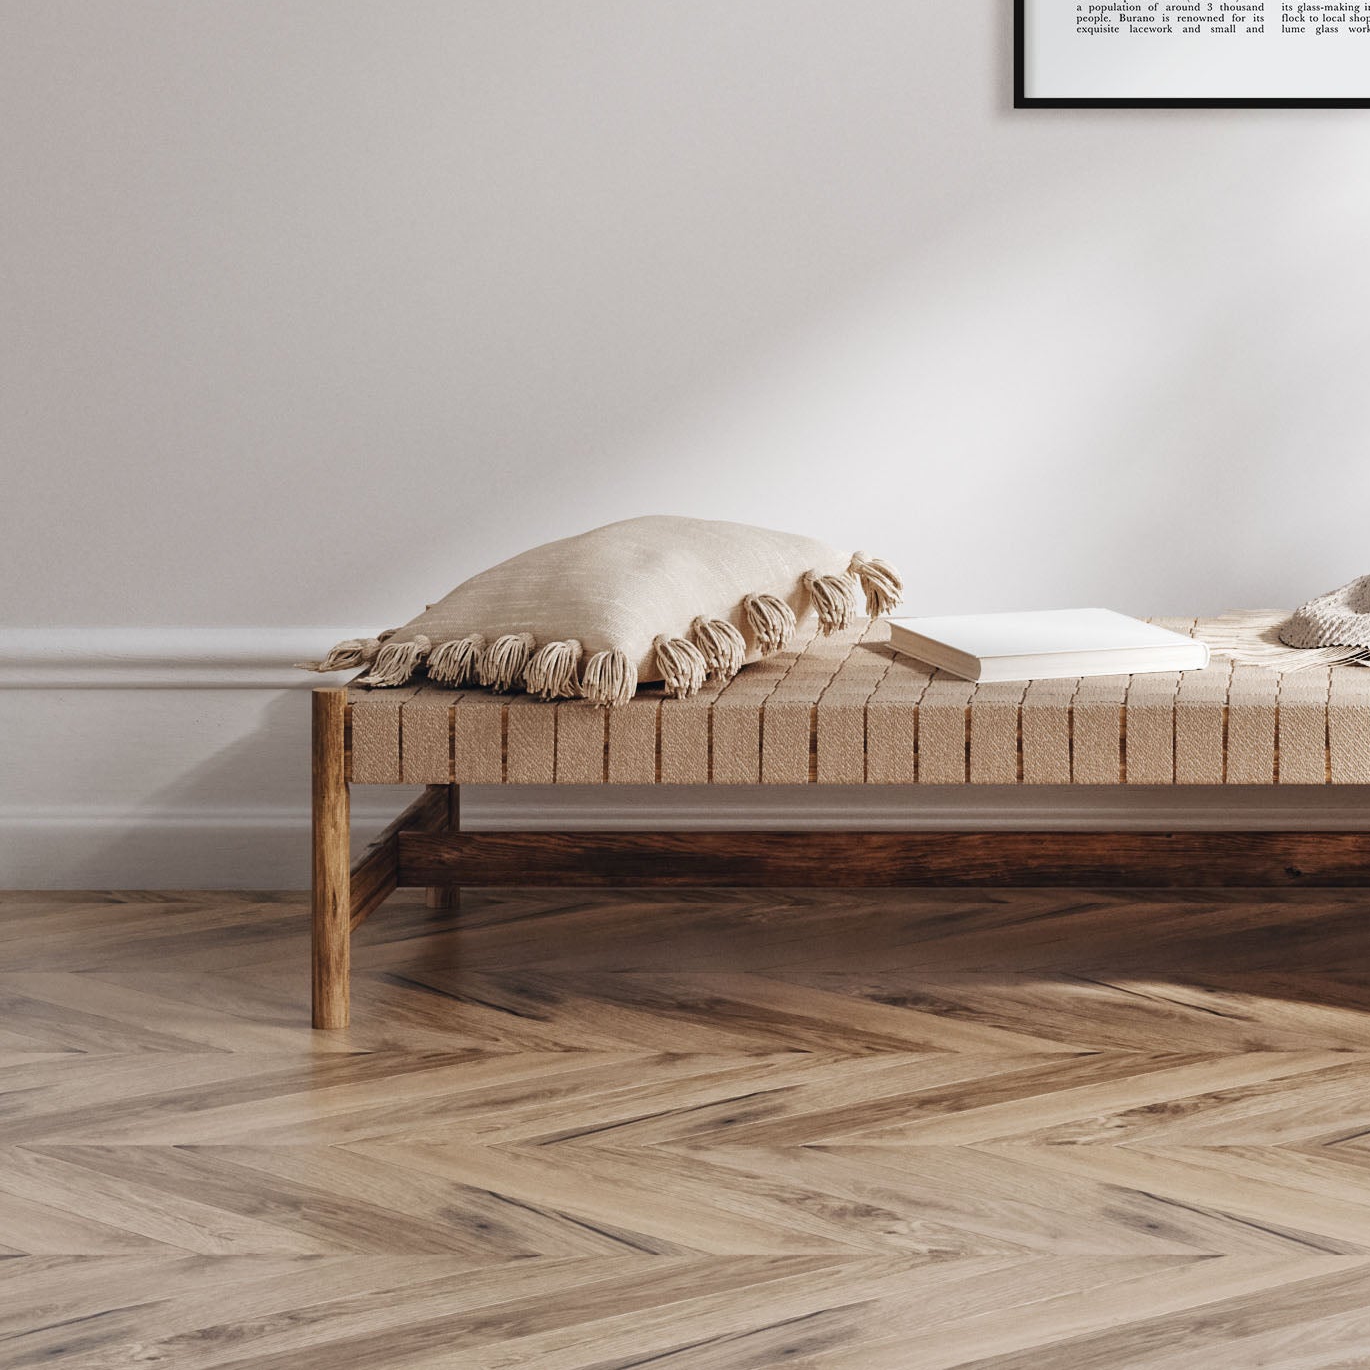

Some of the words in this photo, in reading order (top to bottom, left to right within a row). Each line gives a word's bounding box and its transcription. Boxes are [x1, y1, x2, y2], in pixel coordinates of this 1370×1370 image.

[1089, 2, 1141, 14] population
[1148, 2, 1159, 11] of
[1166, 2, 1200, 11] around
[1208, 2, 1212, 11] 3
[1220, 2, 1264, 11] thousand
[1282, 2, 1293, 11] its
[1298, 2, 1360, 14] glass-making
[1077, 13, 1111, 25] people.
[1120, 13, 1154, 22] Burano
[1163, 13, 1169, 22] is
[1178, 13, 1224, 22] renowned
[1232, 13, 1246, 22] for
[1254, 13, 1264, 22] its
[1077, 24, 1119, 36] exquisite
[1130, 24, 1172, 33] lacework
[1183, 24, 1200, 33] and
[1211, 24, 1235, 33] small
[1246, 24, 1264, 33] and
[1282, 24, 1305, 33] lume
[1316, 24, 1338, 36] glass
